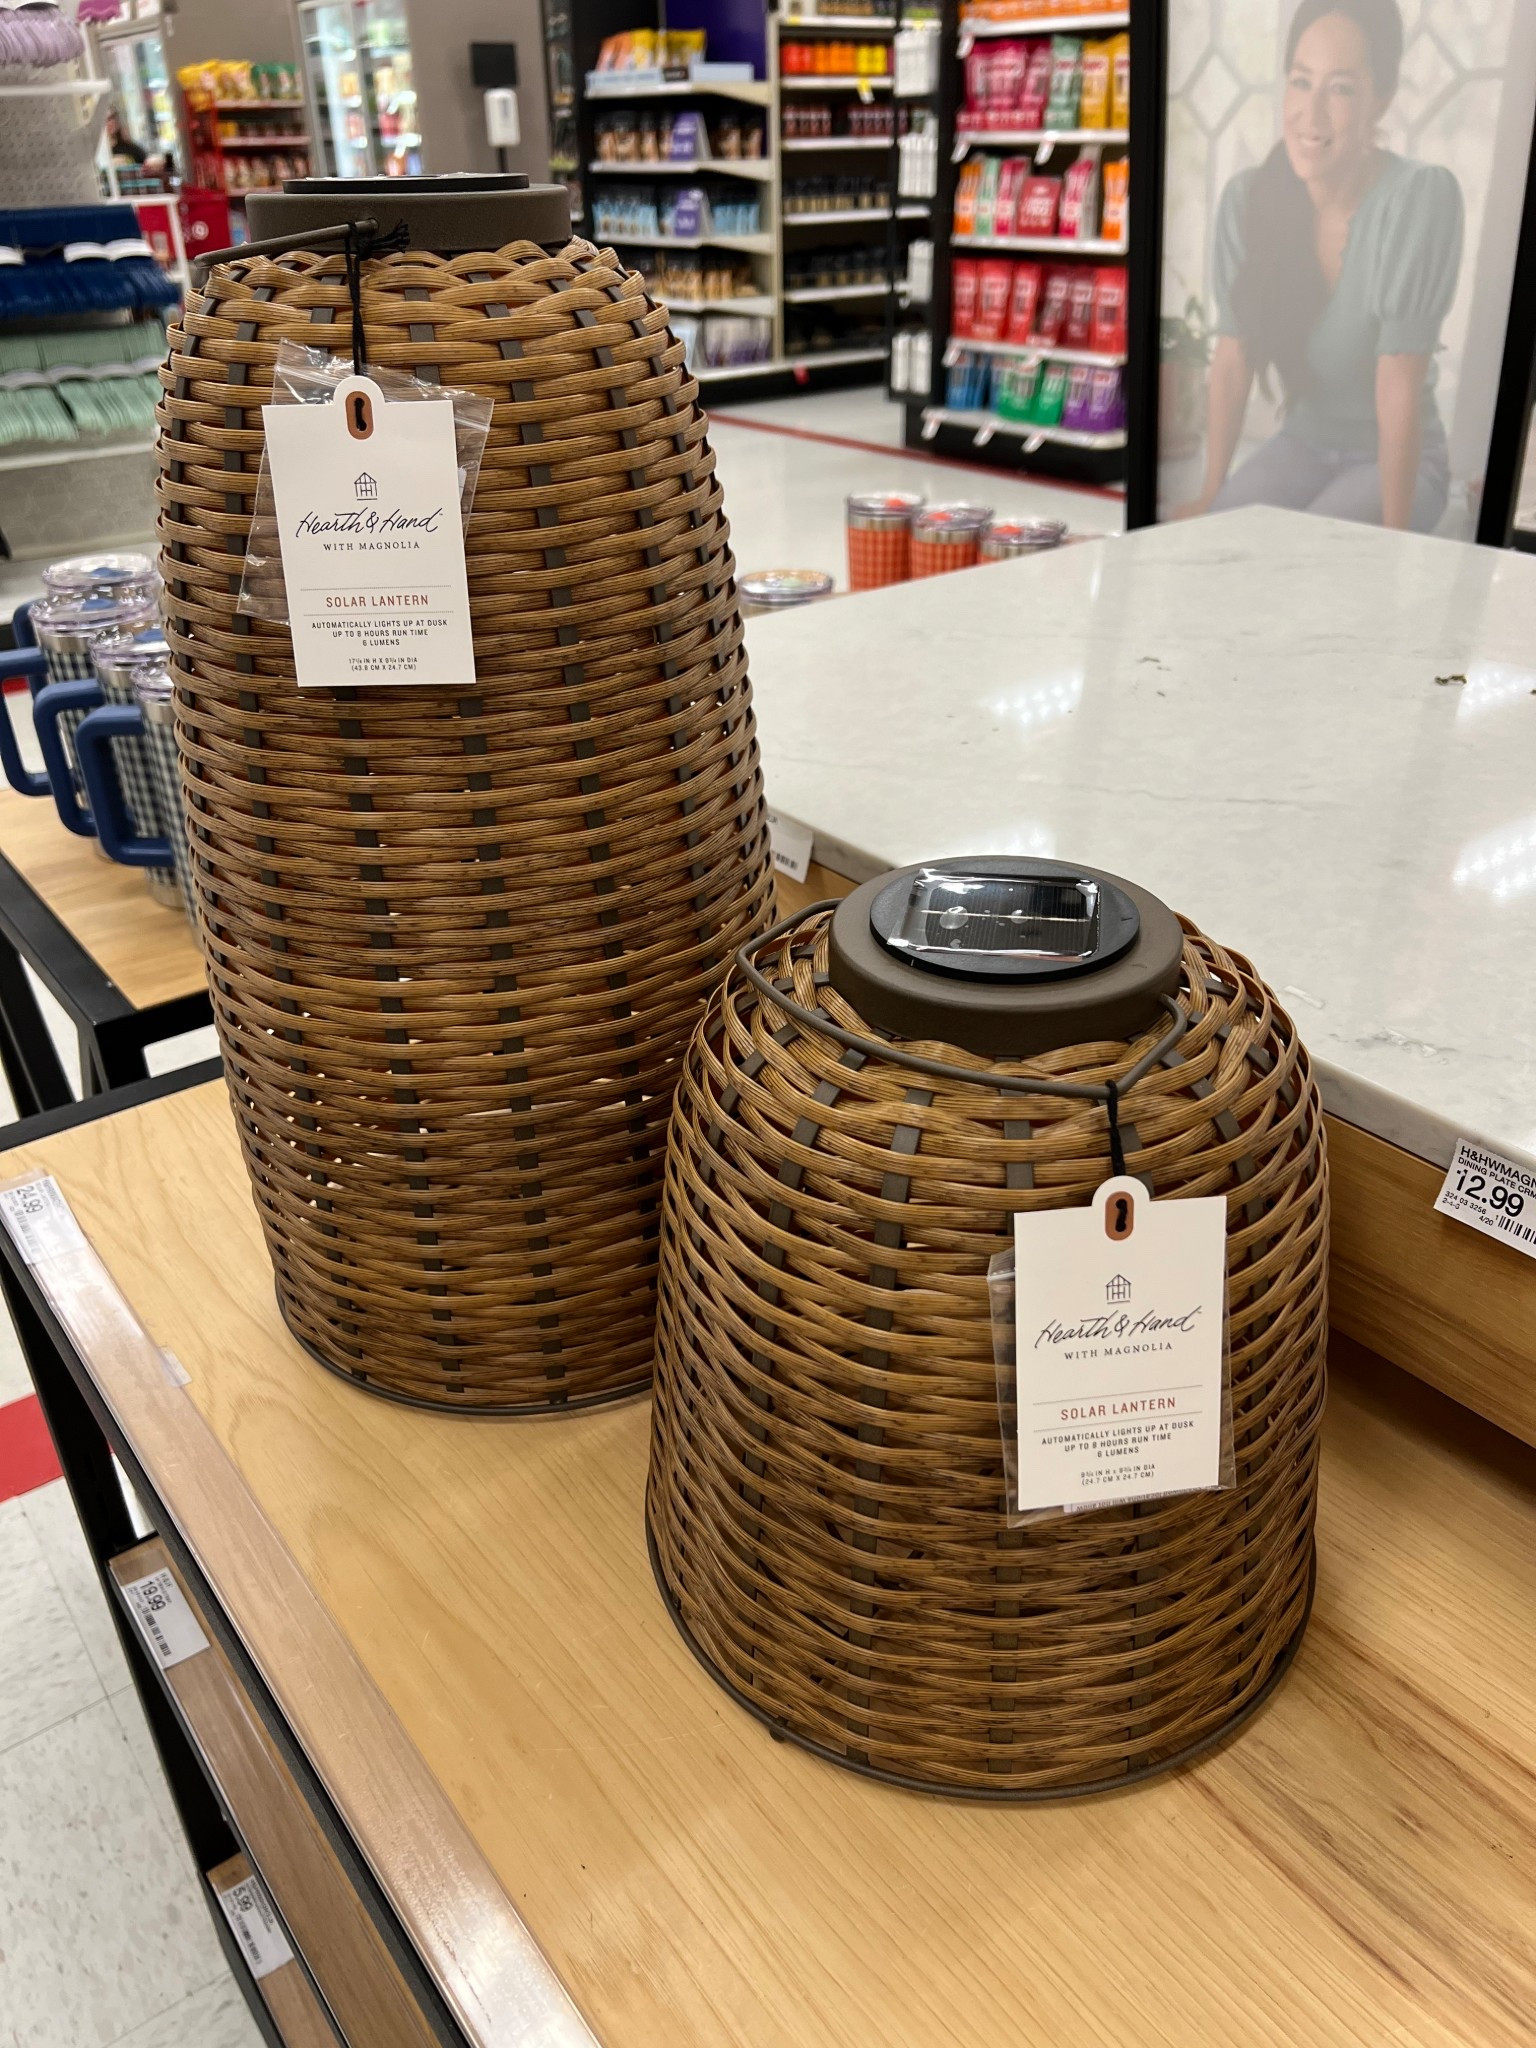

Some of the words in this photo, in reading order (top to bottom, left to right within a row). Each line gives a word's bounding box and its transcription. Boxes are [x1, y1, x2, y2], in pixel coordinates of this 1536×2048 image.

[296, 507, 368, 538] Hearth
[366, 511, 379, 534] &
[379, 508, 442, 533] Hand
[323, 543, 354, 551] WITH
[358, 541, 420, 550] MAGNOLIA
[326, 596, 367, 608] SOLAR
[371, 594, 429, 607] LANTERN
[311, 621, 372, 629] AUTOMATICALLY
[374, 620, 400, 628] LIGHTS
[415, 619, 424, 627] AT
[345, 630, 355, 638] TO
[392, 629, 408, 637] RUN
[362, 639, 368, 647] 6
[370, 638, 400, 646] LUMENS
[1458, 1157, 1487, 1176] DINING
[1489, 1172, 1517, 1190] PLATE
[16, 1186, 43, 1213] 24.99
[1445, 1191, 1458, 1201] 324
[1460, 1198, 1468, 1206] 03
[1456, 1169, 1525, 1218] 12.99
[1479, 1215, 1494, 1226] 4/20
[1034, 1310, 1118, 1349] Hearth
[1115, 1313, 1130, 1338] &
[1129, 1305, 1202, 1333] Hand
[1064, 1350, 1098, 1360] WITH
[1104, 1342, 1173, 1356] MAGNOLIA
[1060, 1404, 1106, 1421] SOLAR
[1112, 1396, 1176, 1415] LANTERN
[1041, 1430, 1110, 1445] AUTOMATICALLY
[1113, 1427, 1143, 1437] LIGHTS
[1145, 1425, 1157, 1433] UP
[1159, 1423, 1169, 1431] AT
[1172, 1420, 1194, 1430] DUSK
[1064, 1444, 1076, 1453] UP
[1079, 1442, 1090, 1451] TO
[1092, 1441, 1098, 1449] 8
[1100, 1438, 1129, 1448] HOURS
[1131, 1435, 1149, 1444] RUN
[1152, 1433, 1172, 1442] TIME
[1105, 1446, 1140, 1457] LUMENS
[1081, 1477, 1100, 1486] (24.7
[1122, 1473, 1138, 1481] 24.7
[140, 1581, 167, 1611] 19.99
